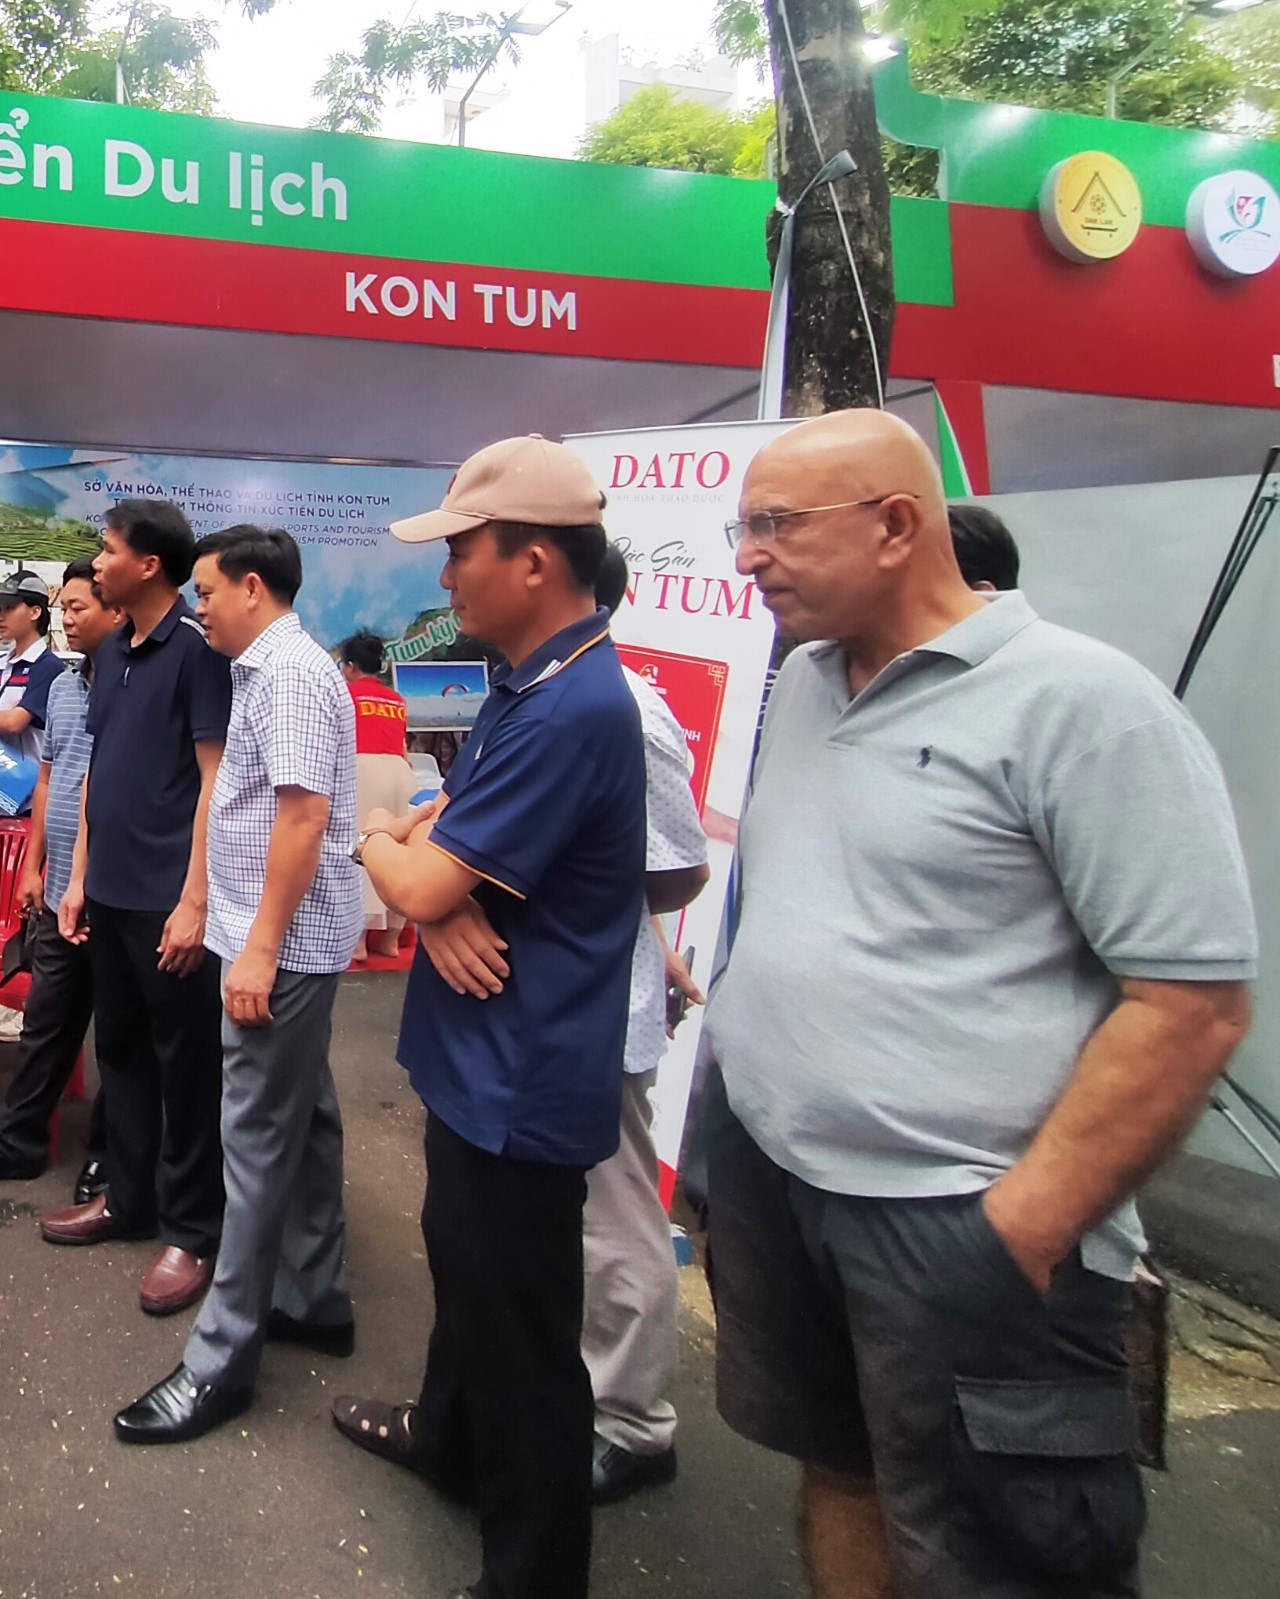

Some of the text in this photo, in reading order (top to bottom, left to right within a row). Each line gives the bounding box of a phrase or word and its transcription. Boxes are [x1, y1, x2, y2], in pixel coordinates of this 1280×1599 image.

[104, 138, 200, 205] Du
[228, 151, 348, 226] lịch
[345, 272, 577, 331] KON TUM
[608, 450, 731, 489] DATO
[198, 487, 232, 500] THAO
[337, 494, 363, 505] KON
[366, 495, 390, 506] TUM
[236, 503, 257, 515] TIN
[319, 507, 335, 518] DU
[86, 514, 105, 523] KO
[321, 524, 344, 534] AND
[347, 525, 390, 535] TOURISM
[317, 537, 378, 547] PROMOTION
[653, 573, 757, 620] TUM
[359, 701, 406, 721] DATO
